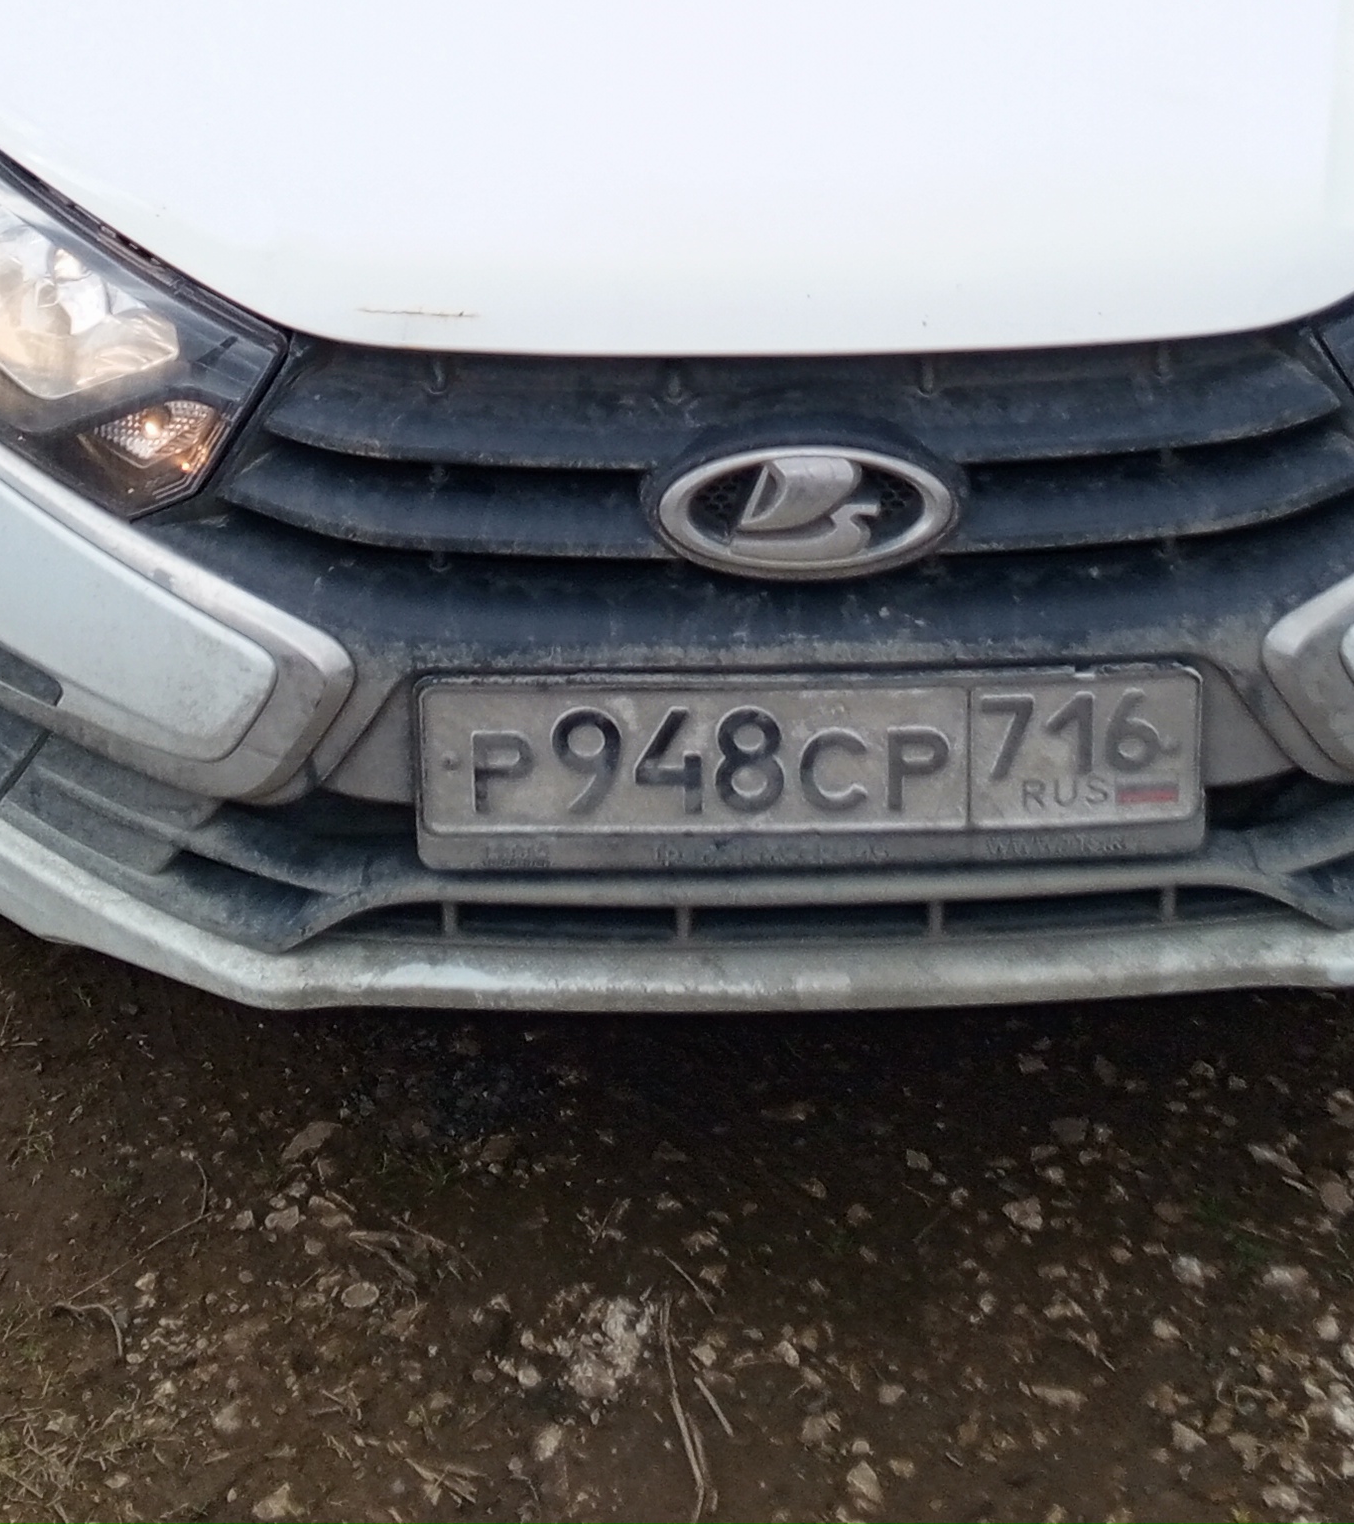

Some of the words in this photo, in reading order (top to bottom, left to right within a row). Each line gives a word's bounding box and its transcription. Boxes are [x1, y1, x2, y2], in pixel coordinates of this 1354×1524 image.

[471, 705, 949, 815] Р948СР
[980, 687, 1162, 780] 716
[1021, 775, 1108, 814] RUS
